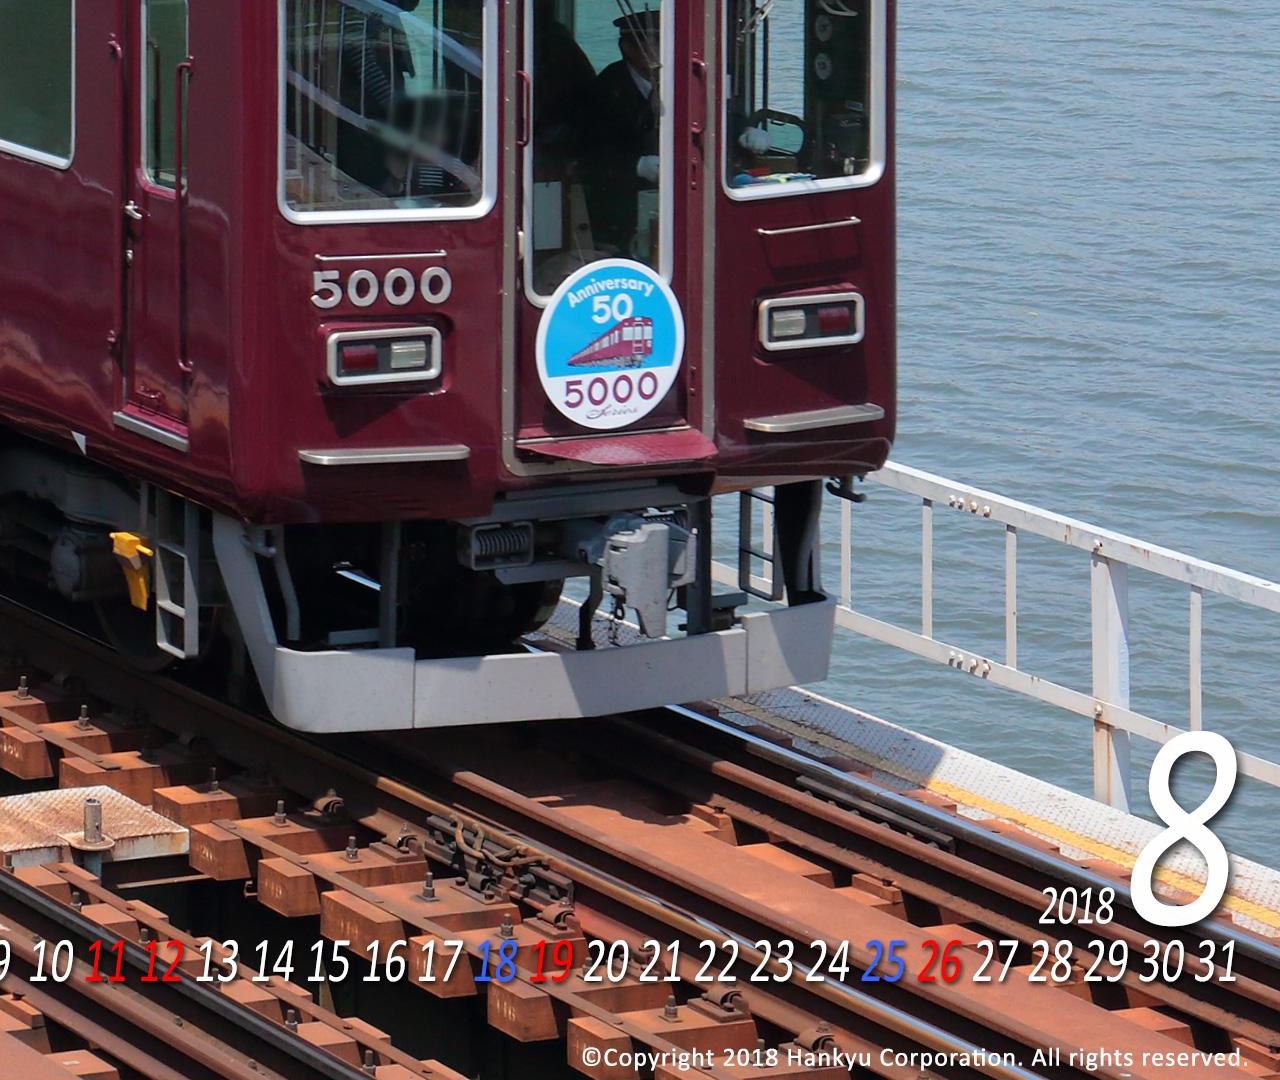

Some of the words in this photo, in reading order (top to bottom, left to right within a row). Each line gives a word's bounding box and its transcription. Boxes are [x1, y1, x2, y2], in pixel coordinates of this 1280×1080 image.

[310, 266, 452, 309] 5000
[566, 277, 654, 308] Anniversary
[591, 293, 634, 324] 50
[564, 371, 658, 408] 5000
